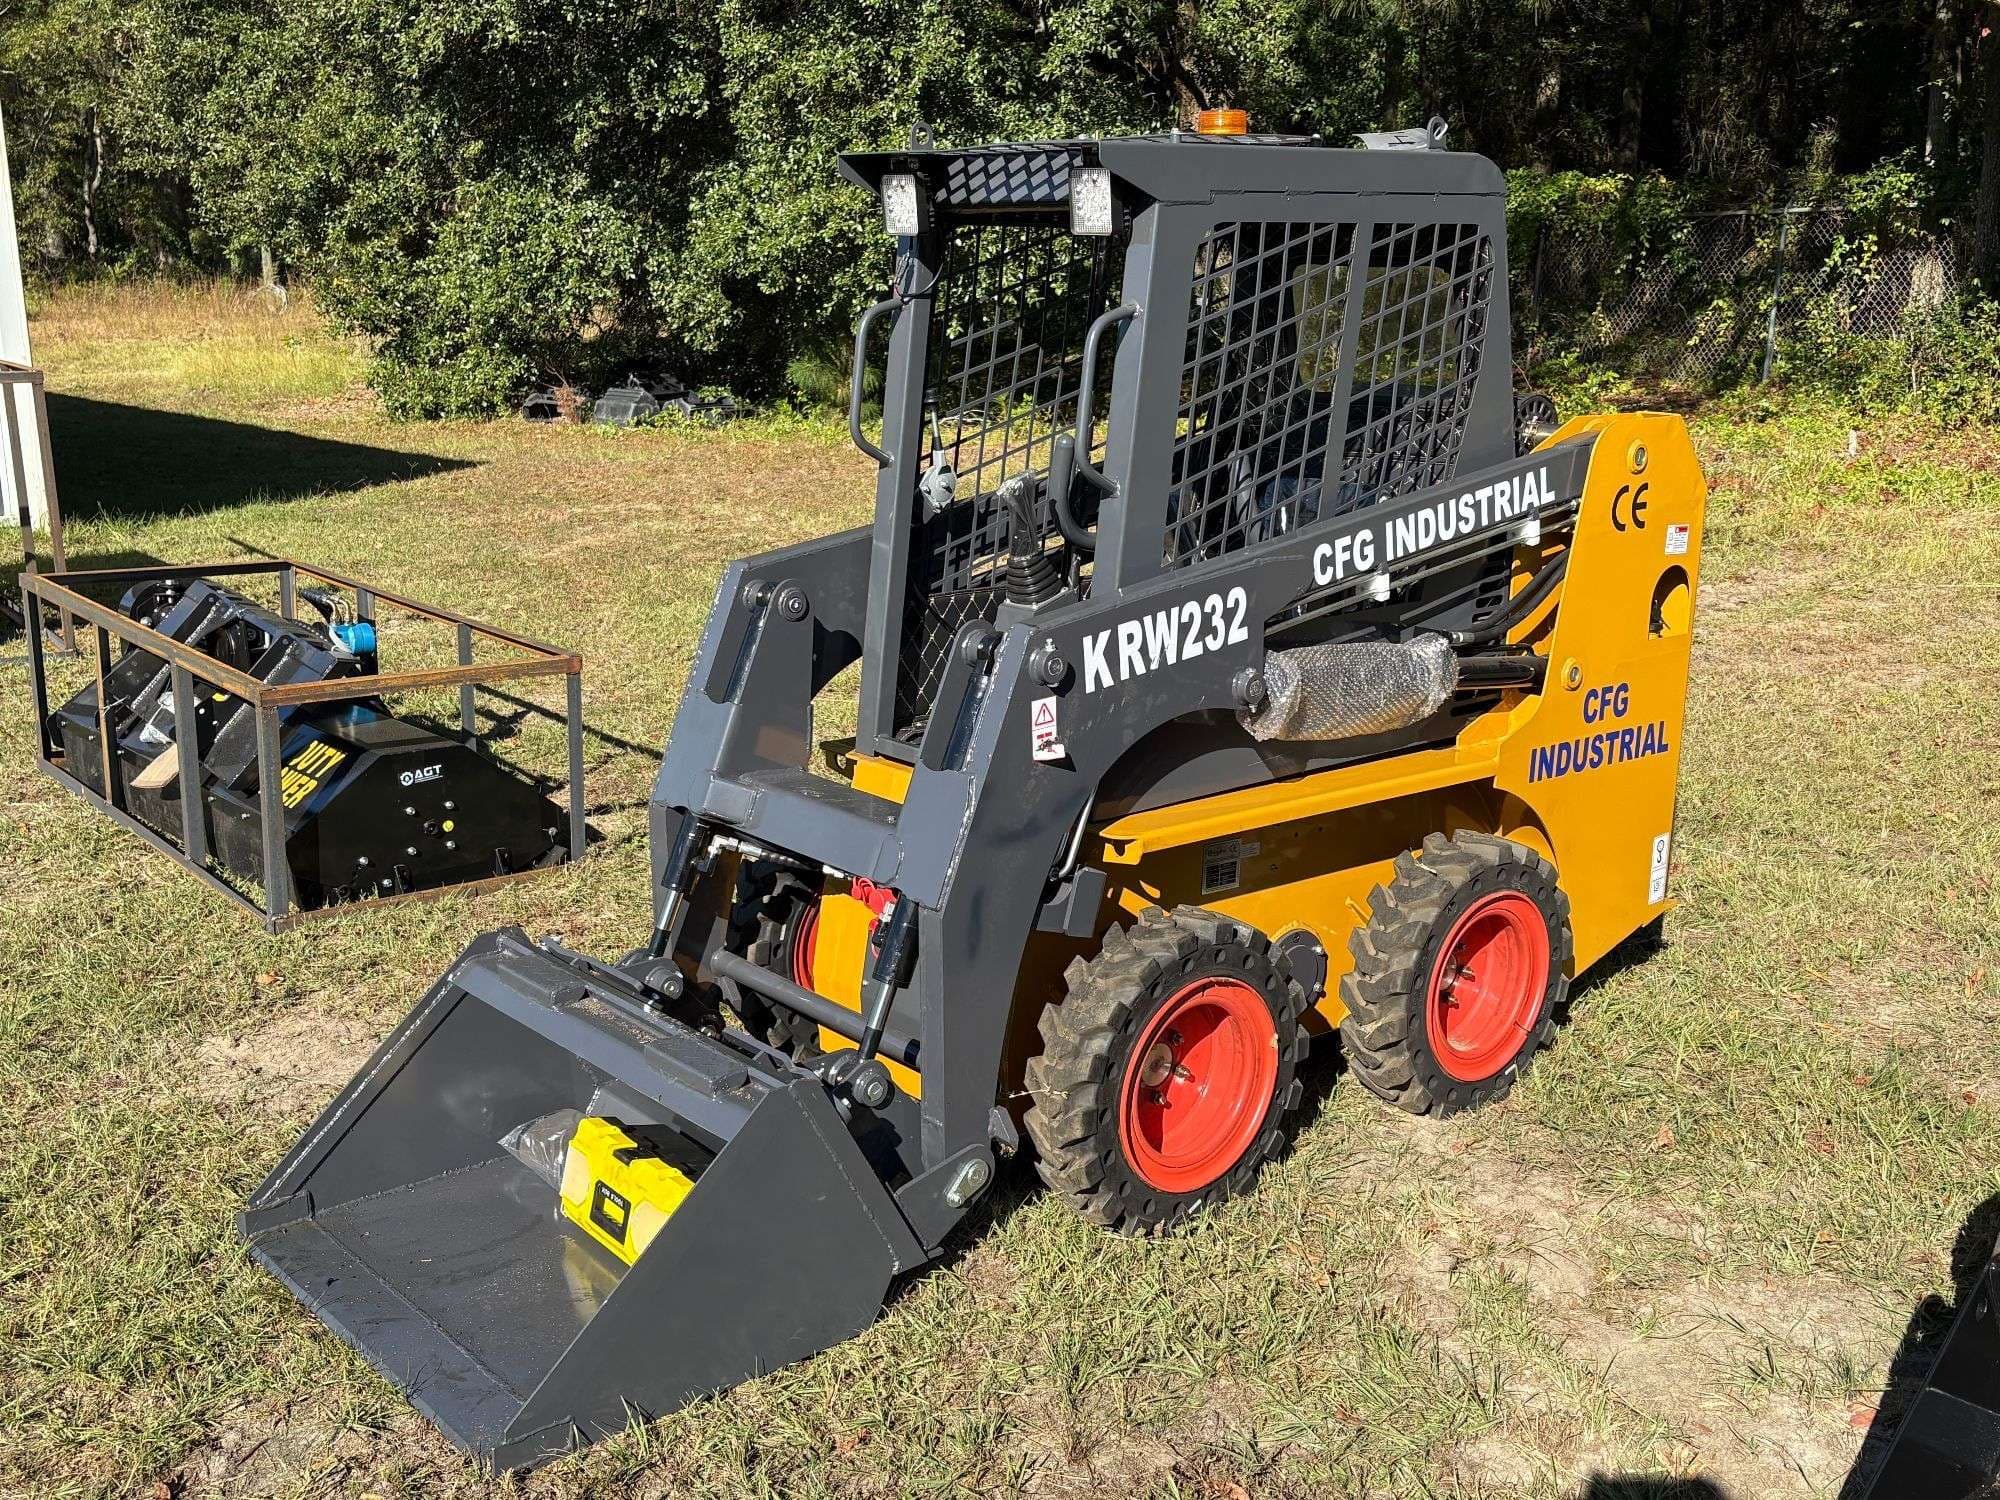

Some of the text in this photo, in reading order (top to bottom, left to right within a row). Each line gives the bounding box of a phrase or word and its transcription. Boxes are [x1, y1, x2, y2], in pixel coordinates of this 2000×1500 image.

[1313, 467, 1556, 586] CFG INDUSTRIAL
[1611, 482, 1649, 532] CE
[1082, 586, 1249, 694] KRW232
[1583, 682, 1630, 724] CFG
[414, 764, 442, 779] AGT
[1528, 720, 1669, 784] INDUSTRIAL
